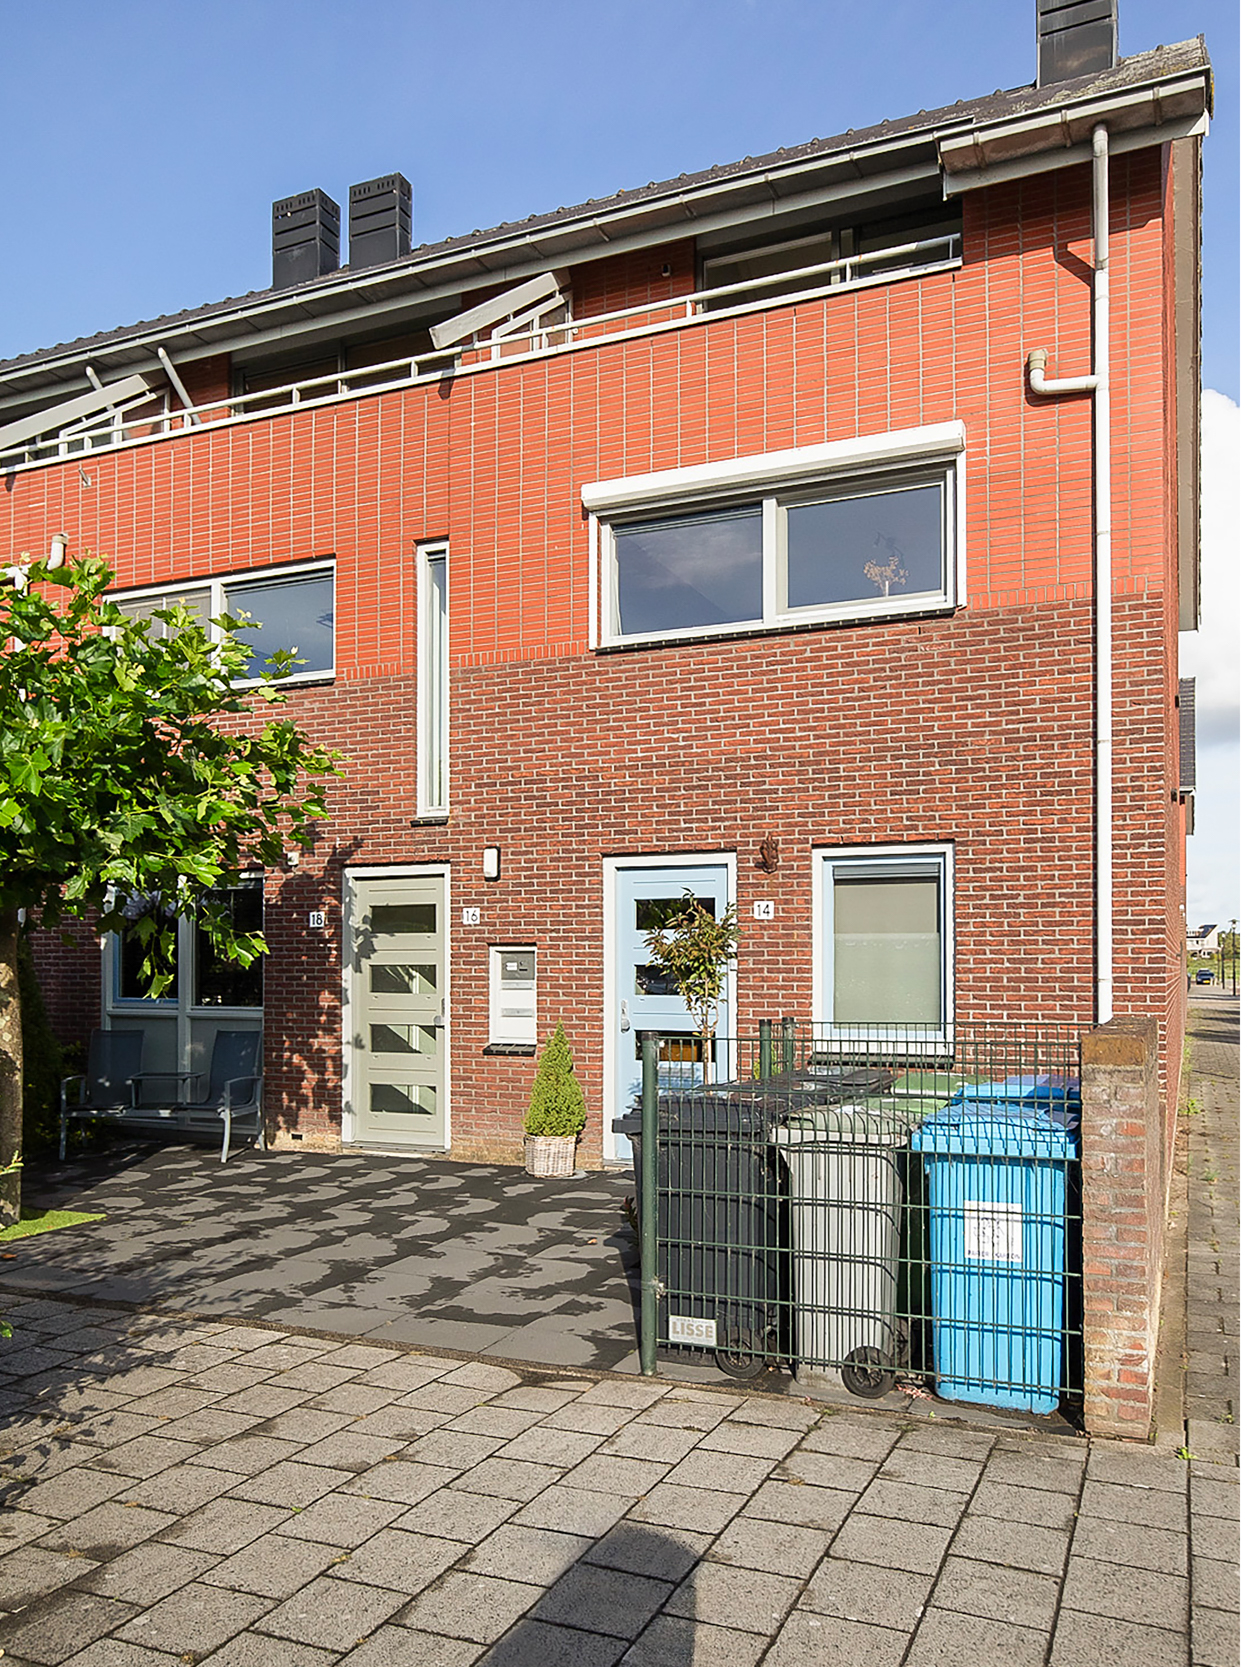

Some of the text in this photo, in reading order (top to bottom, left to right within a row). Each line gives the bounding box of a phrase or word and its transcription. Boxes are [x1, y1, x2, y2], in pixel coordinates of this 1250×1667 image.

[466, 910, 478, 922] 16
[757, 904, 770, 917] 14
[312, 914, 323, 926] 18
[672, 1321, 713, 1339] LISSE
